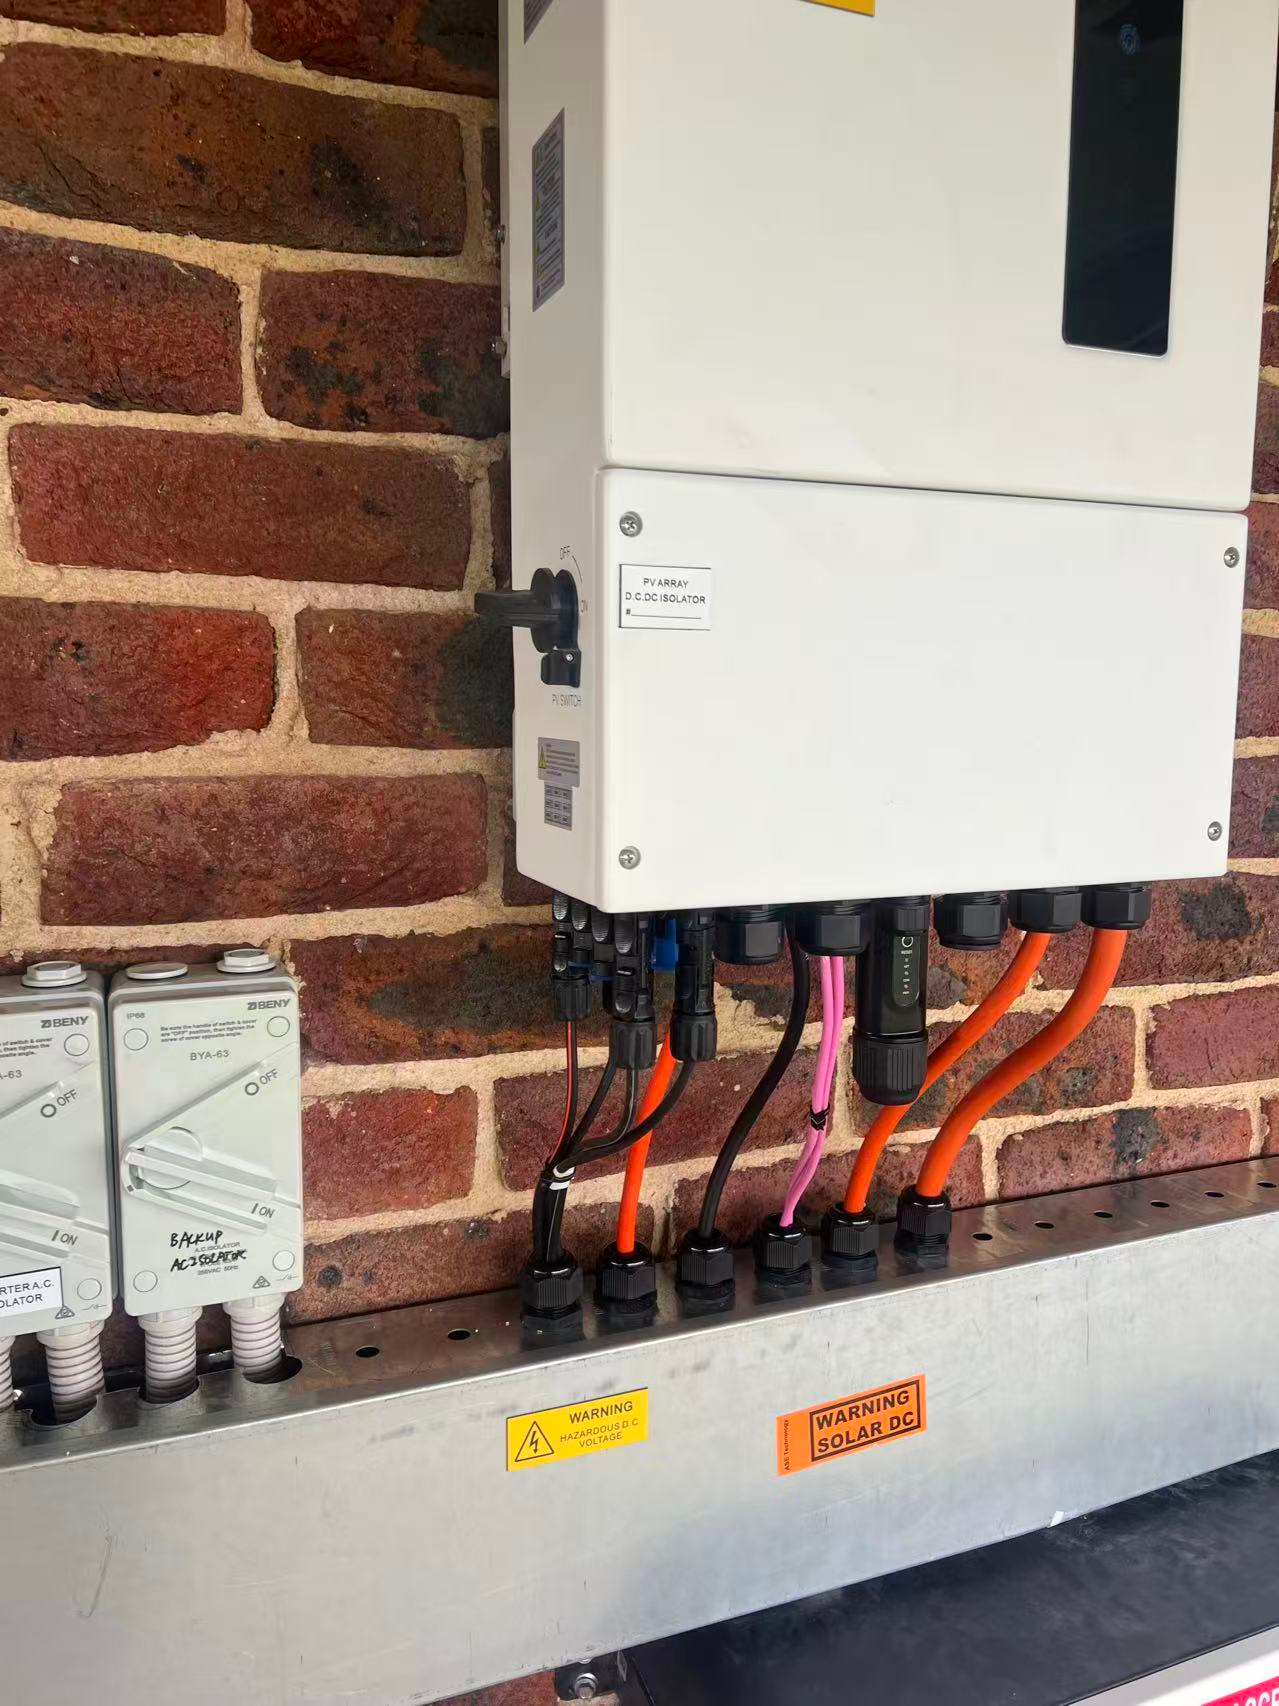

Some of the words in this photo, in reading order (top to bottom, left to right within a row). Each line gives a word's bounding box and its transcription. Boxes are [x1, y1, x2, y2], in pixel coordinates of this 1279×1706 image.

[560, 545, 570, 560] OFF
[643, 578, 655, 587] PV
[657, 578, 688, 588] ARRAY
[660, 593, 706, 604] ISOLATOR
[190, 1050, 230, 1061] BYA-63
[258, 1068, 279, 1086] OFF
[56, 1089, 77, 1108] OFF
[258, 1206, 276, 1218] ON
[60, 1233, 78, 1246] ON
[170, 1230, 223, 1249] BACKUP
[569, 1400, 634, 1425] WARNING
[816, 1390, 910, 1430] WARNING
[560, 1422, 621, 1442] HAZARDOUS
[578, 1431, 623, 1448] VOLTAGE
[818, 1420, 882, 1454] SOLAR
[889, 1411, 915, 1432] DC
